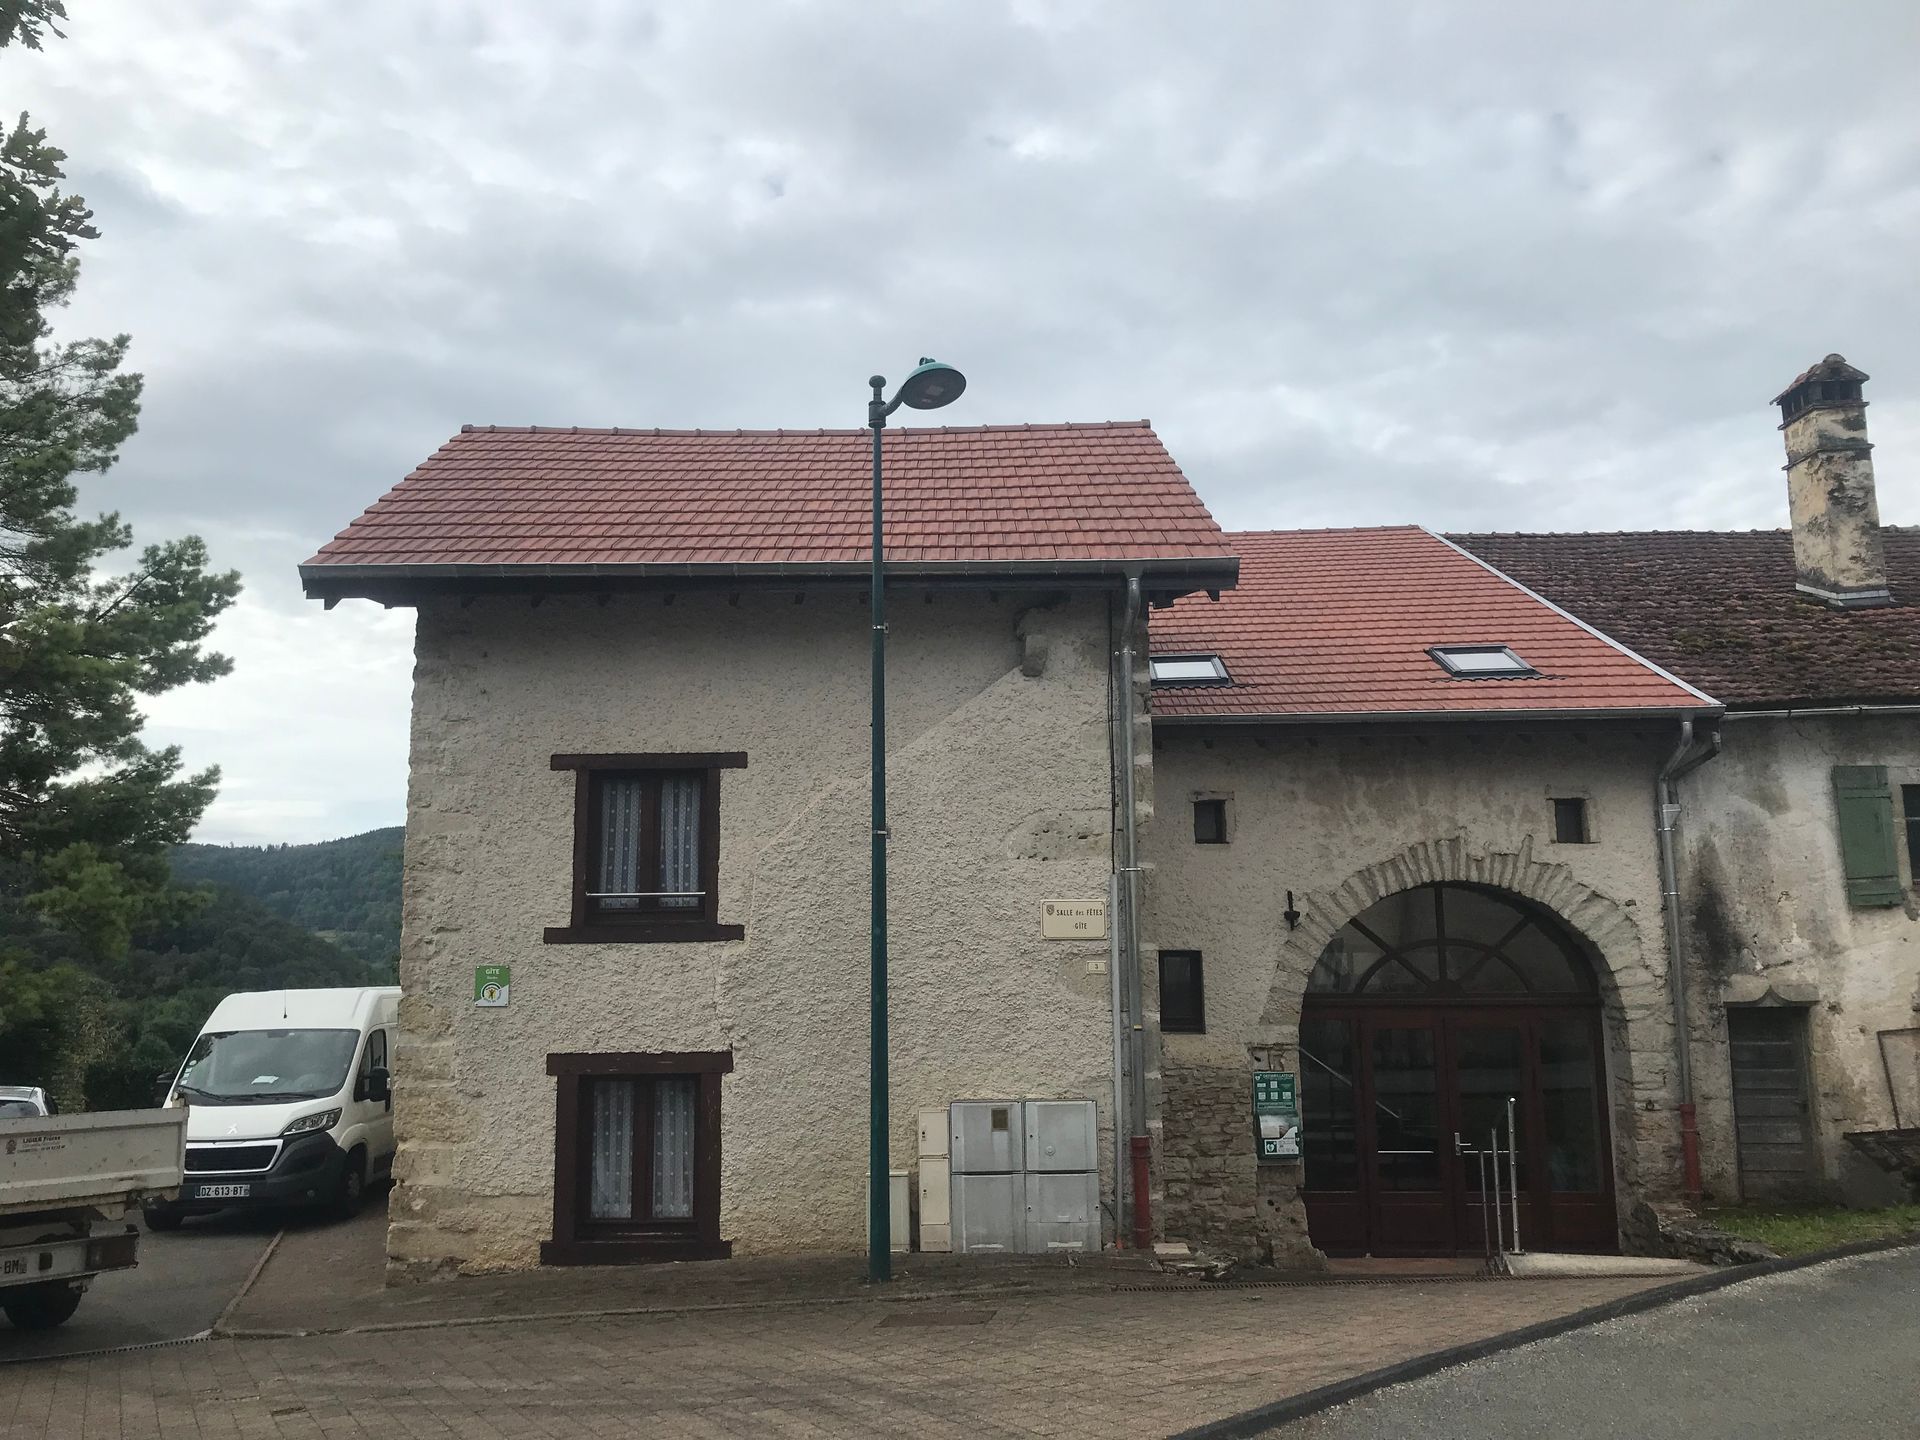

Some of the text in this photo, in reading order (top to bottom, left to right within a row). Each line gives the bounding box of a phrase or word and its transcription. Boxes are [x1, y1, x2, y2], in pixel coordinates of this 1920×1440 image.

[1086, 908, 1103, 916] FÊTES
[1074, 922, 1087, 930] GÎTE
[201, 1186, 244, 1197] DZ-613-BT
